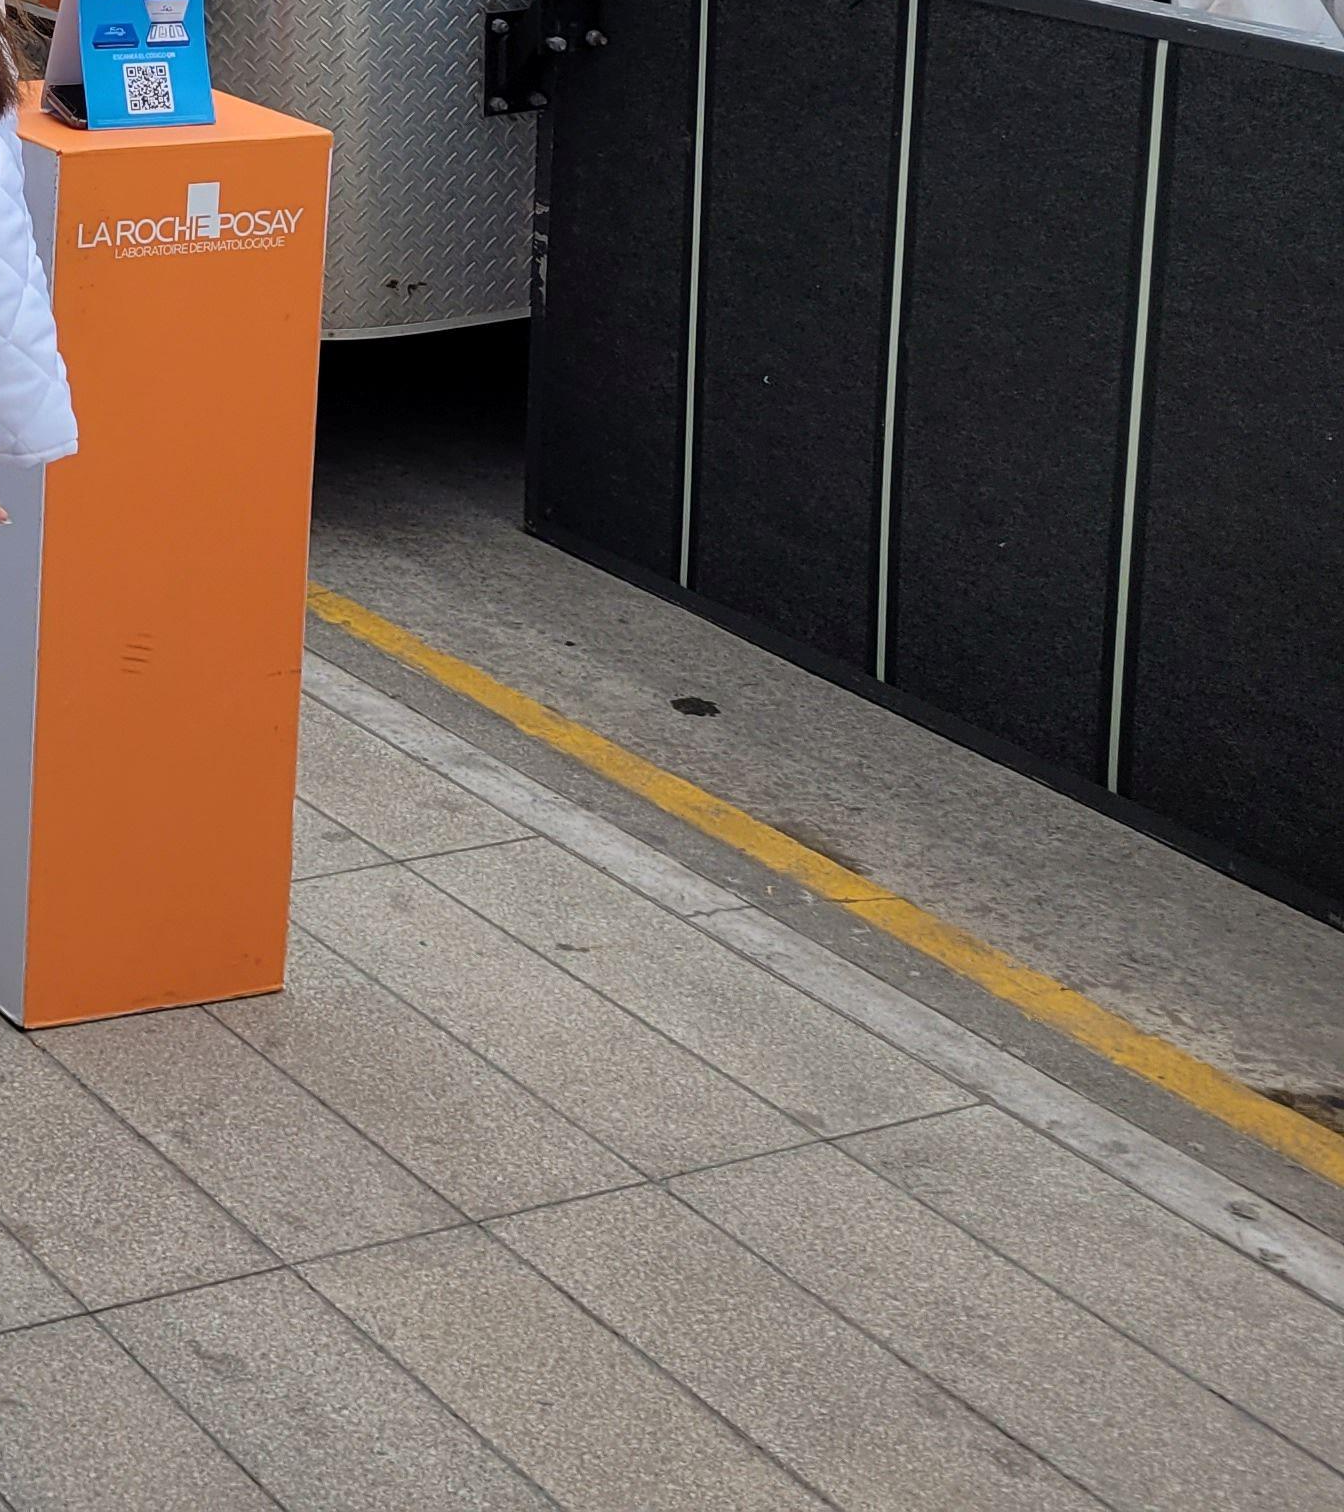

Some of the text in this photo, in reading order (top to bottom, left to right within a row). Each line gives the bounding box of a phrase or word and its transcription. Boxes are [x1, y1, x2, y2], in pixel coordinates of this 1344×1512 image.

[77, 207, 304, 249] LA ROCHE POSAY
[114, 235, 286, 260] LABORATOIRE DERMATOLOGIQUE
